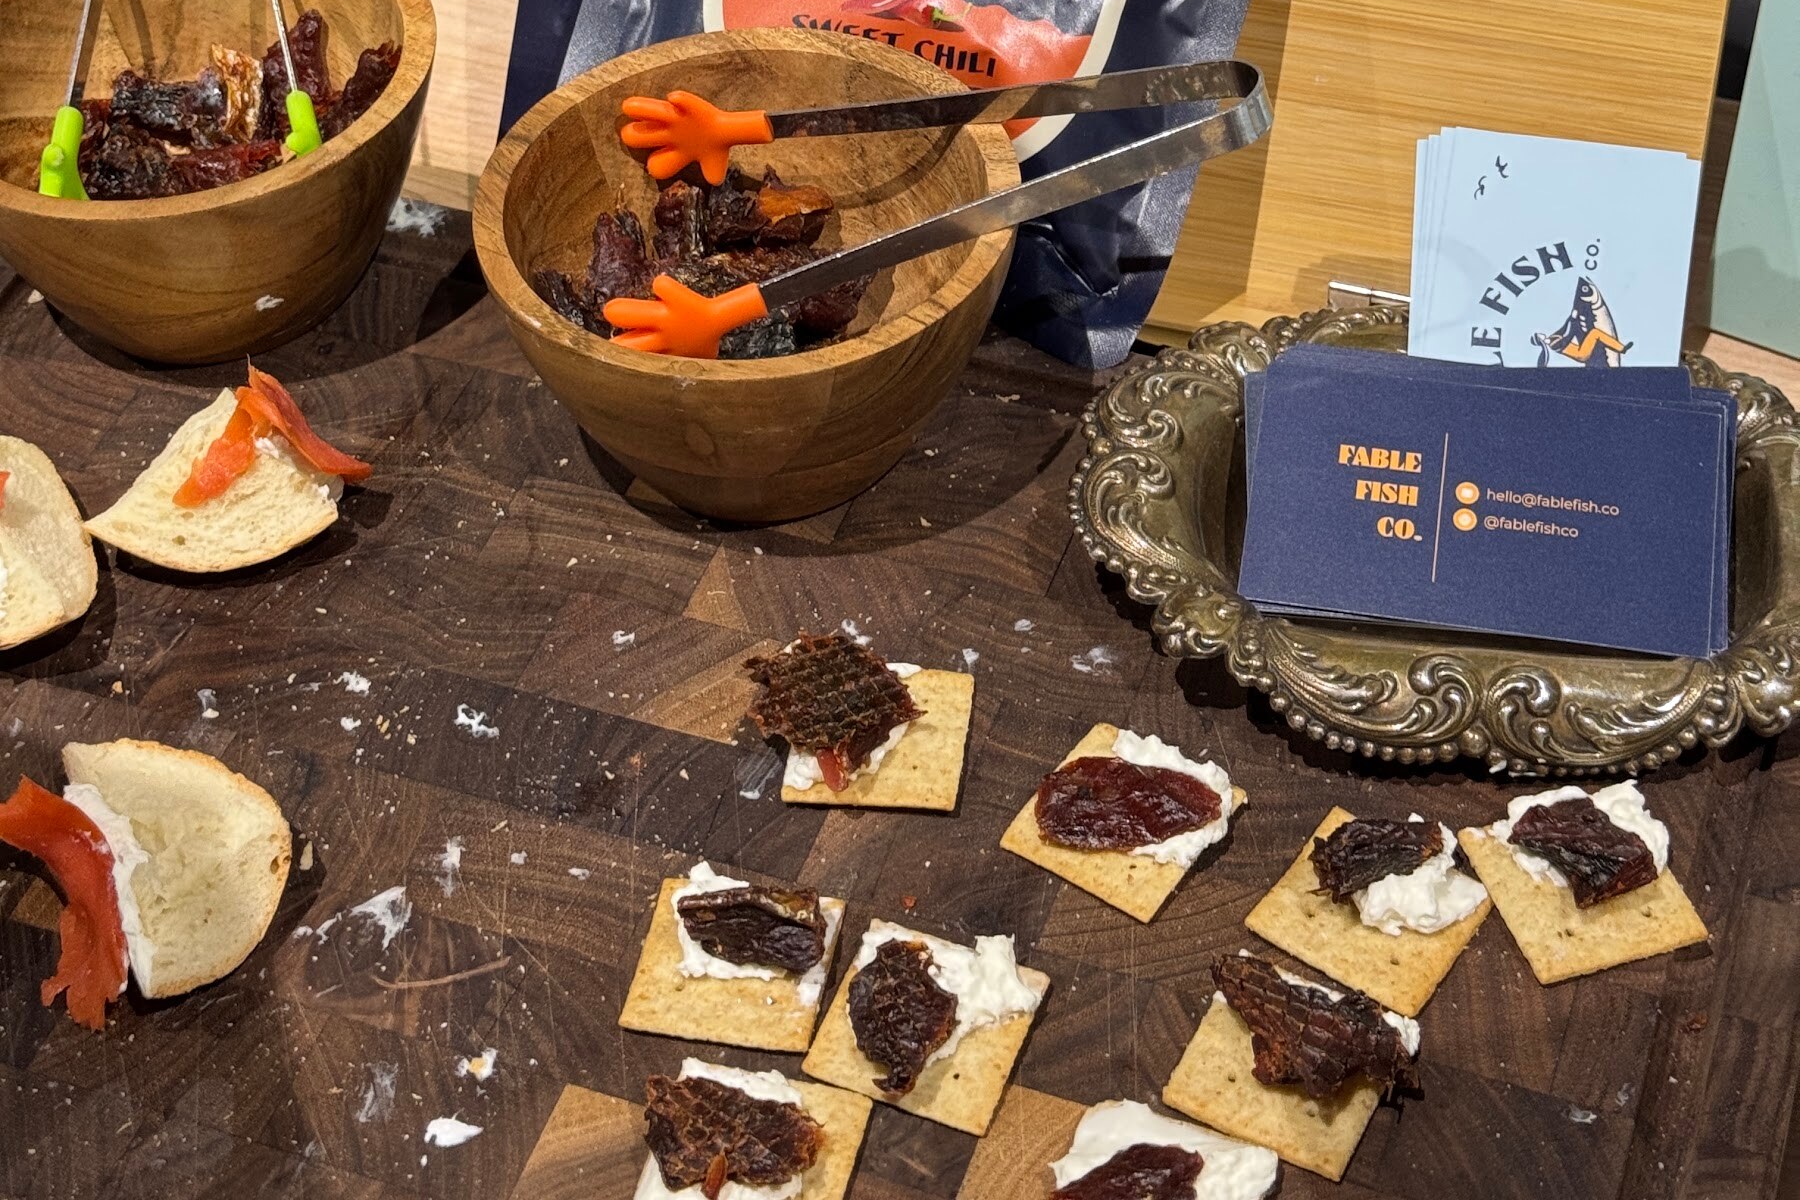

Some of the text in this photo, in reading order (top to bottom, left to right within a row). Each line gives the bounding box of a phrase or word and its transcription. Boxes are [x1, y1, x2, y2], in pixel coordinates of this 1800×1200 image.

[913, 40, 996, 78] CHILI
[1479, 241, 1574, 316] FISH
[1584, 238, 1601, 271] CO.
[1338, 443, 1423, 474] FABLE
[1355, 479, 1420, 507] FISH
[1486, 488, 1620, 517] hello@fablefish.co
[1376, 516, 1423, 542] CO.
[1483, 515, 1580, 539] @fablefishco
